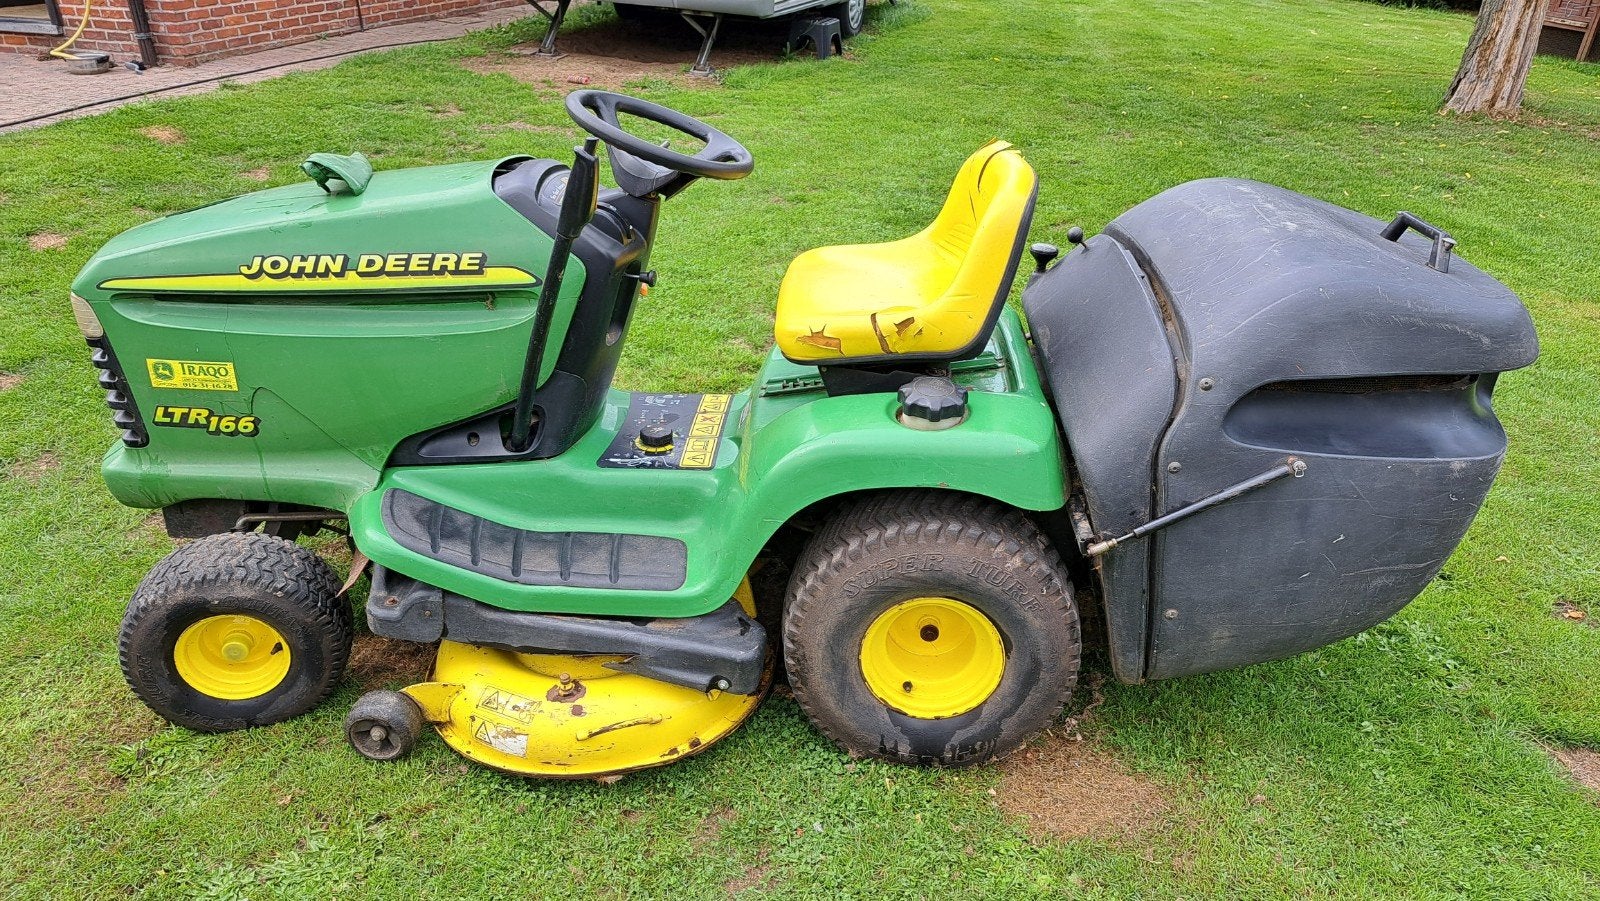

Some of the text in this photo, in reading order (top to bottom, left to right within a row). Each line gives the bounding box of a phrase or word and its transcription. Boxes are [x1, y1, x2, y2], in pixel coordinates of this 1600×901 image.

[239, 252, 487, 279] JOHN DEERE
[179, 362, 229, 378] TRAQO
[841, 552, 1045, 612] SUPER TURF
